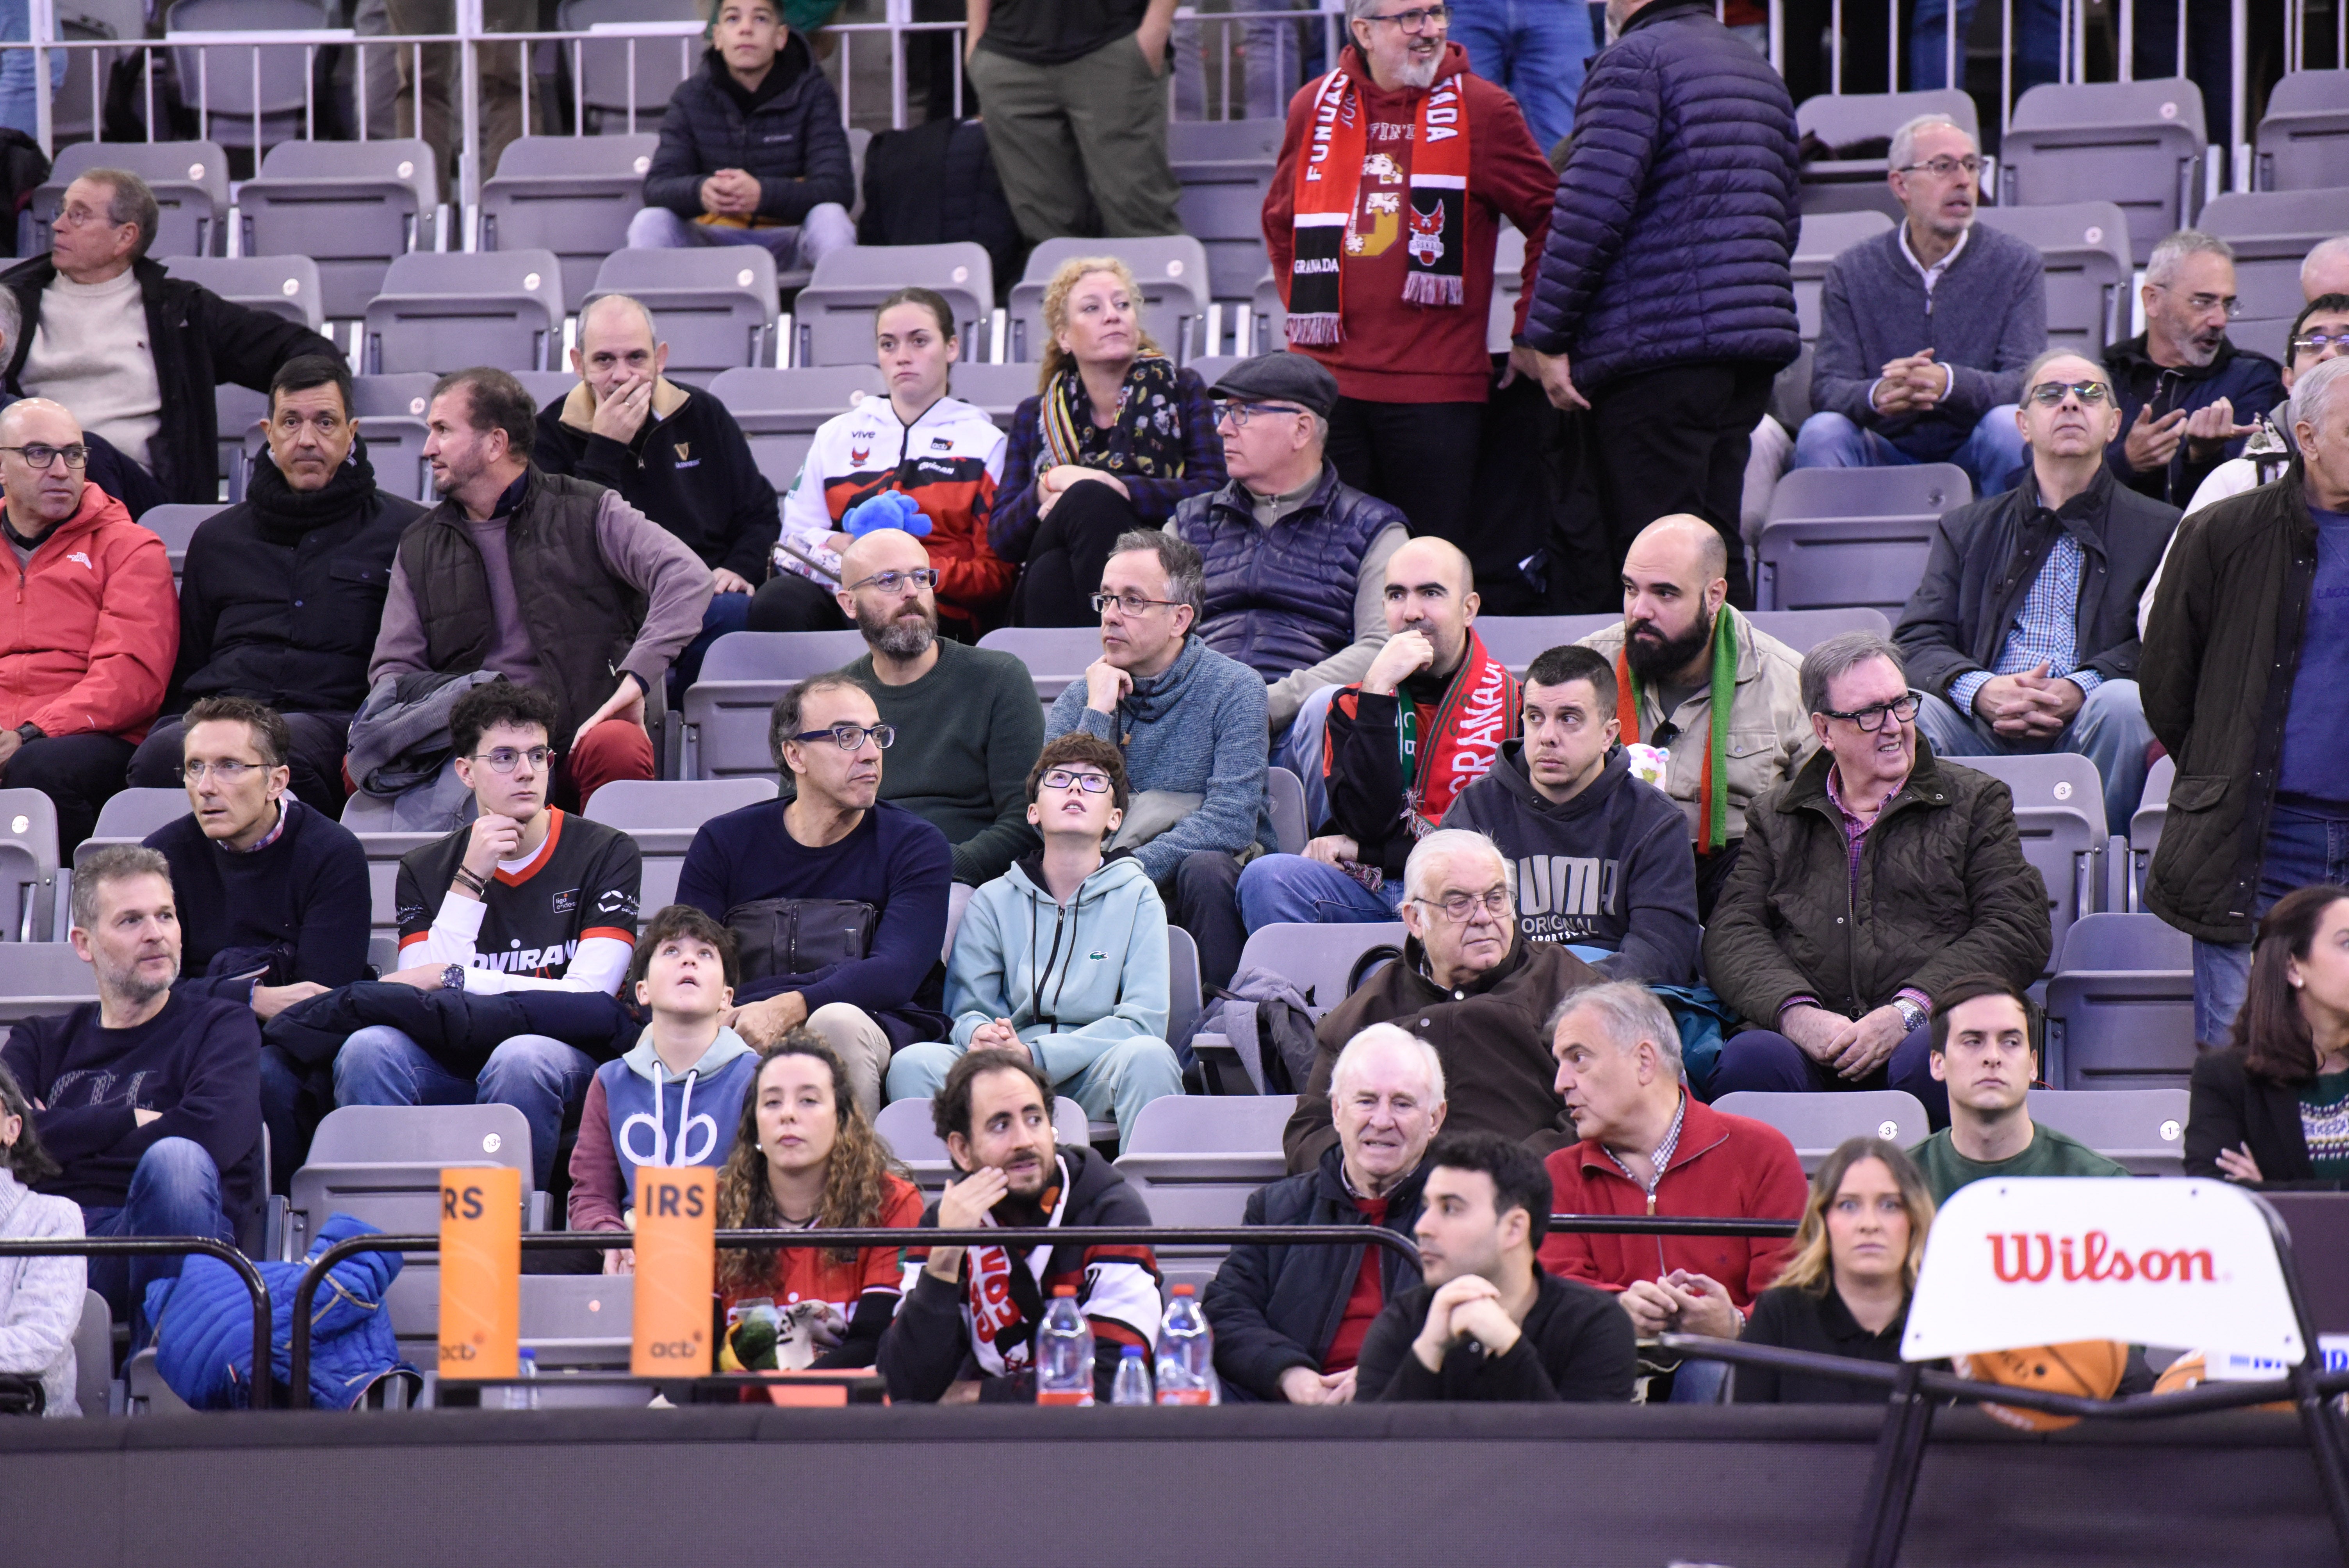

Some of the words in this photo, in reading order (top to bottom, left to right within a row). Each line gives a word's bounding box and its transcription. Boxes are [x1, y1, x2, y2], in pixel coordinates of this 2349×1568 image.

[1294, 258, 1340, 274] GRANADA
[852, 430, 875, 438] vive
[1449, 663, 1502, 795] GRANAD
[1885, 1127, 1891, 1135] 3
[442, 1186, 484, 1219] RS
[645, 1183, 705, 1217] IRS
[1986, 1230, 2217, 1283] Wilson
[650, 1339, 697, 1358] acb
